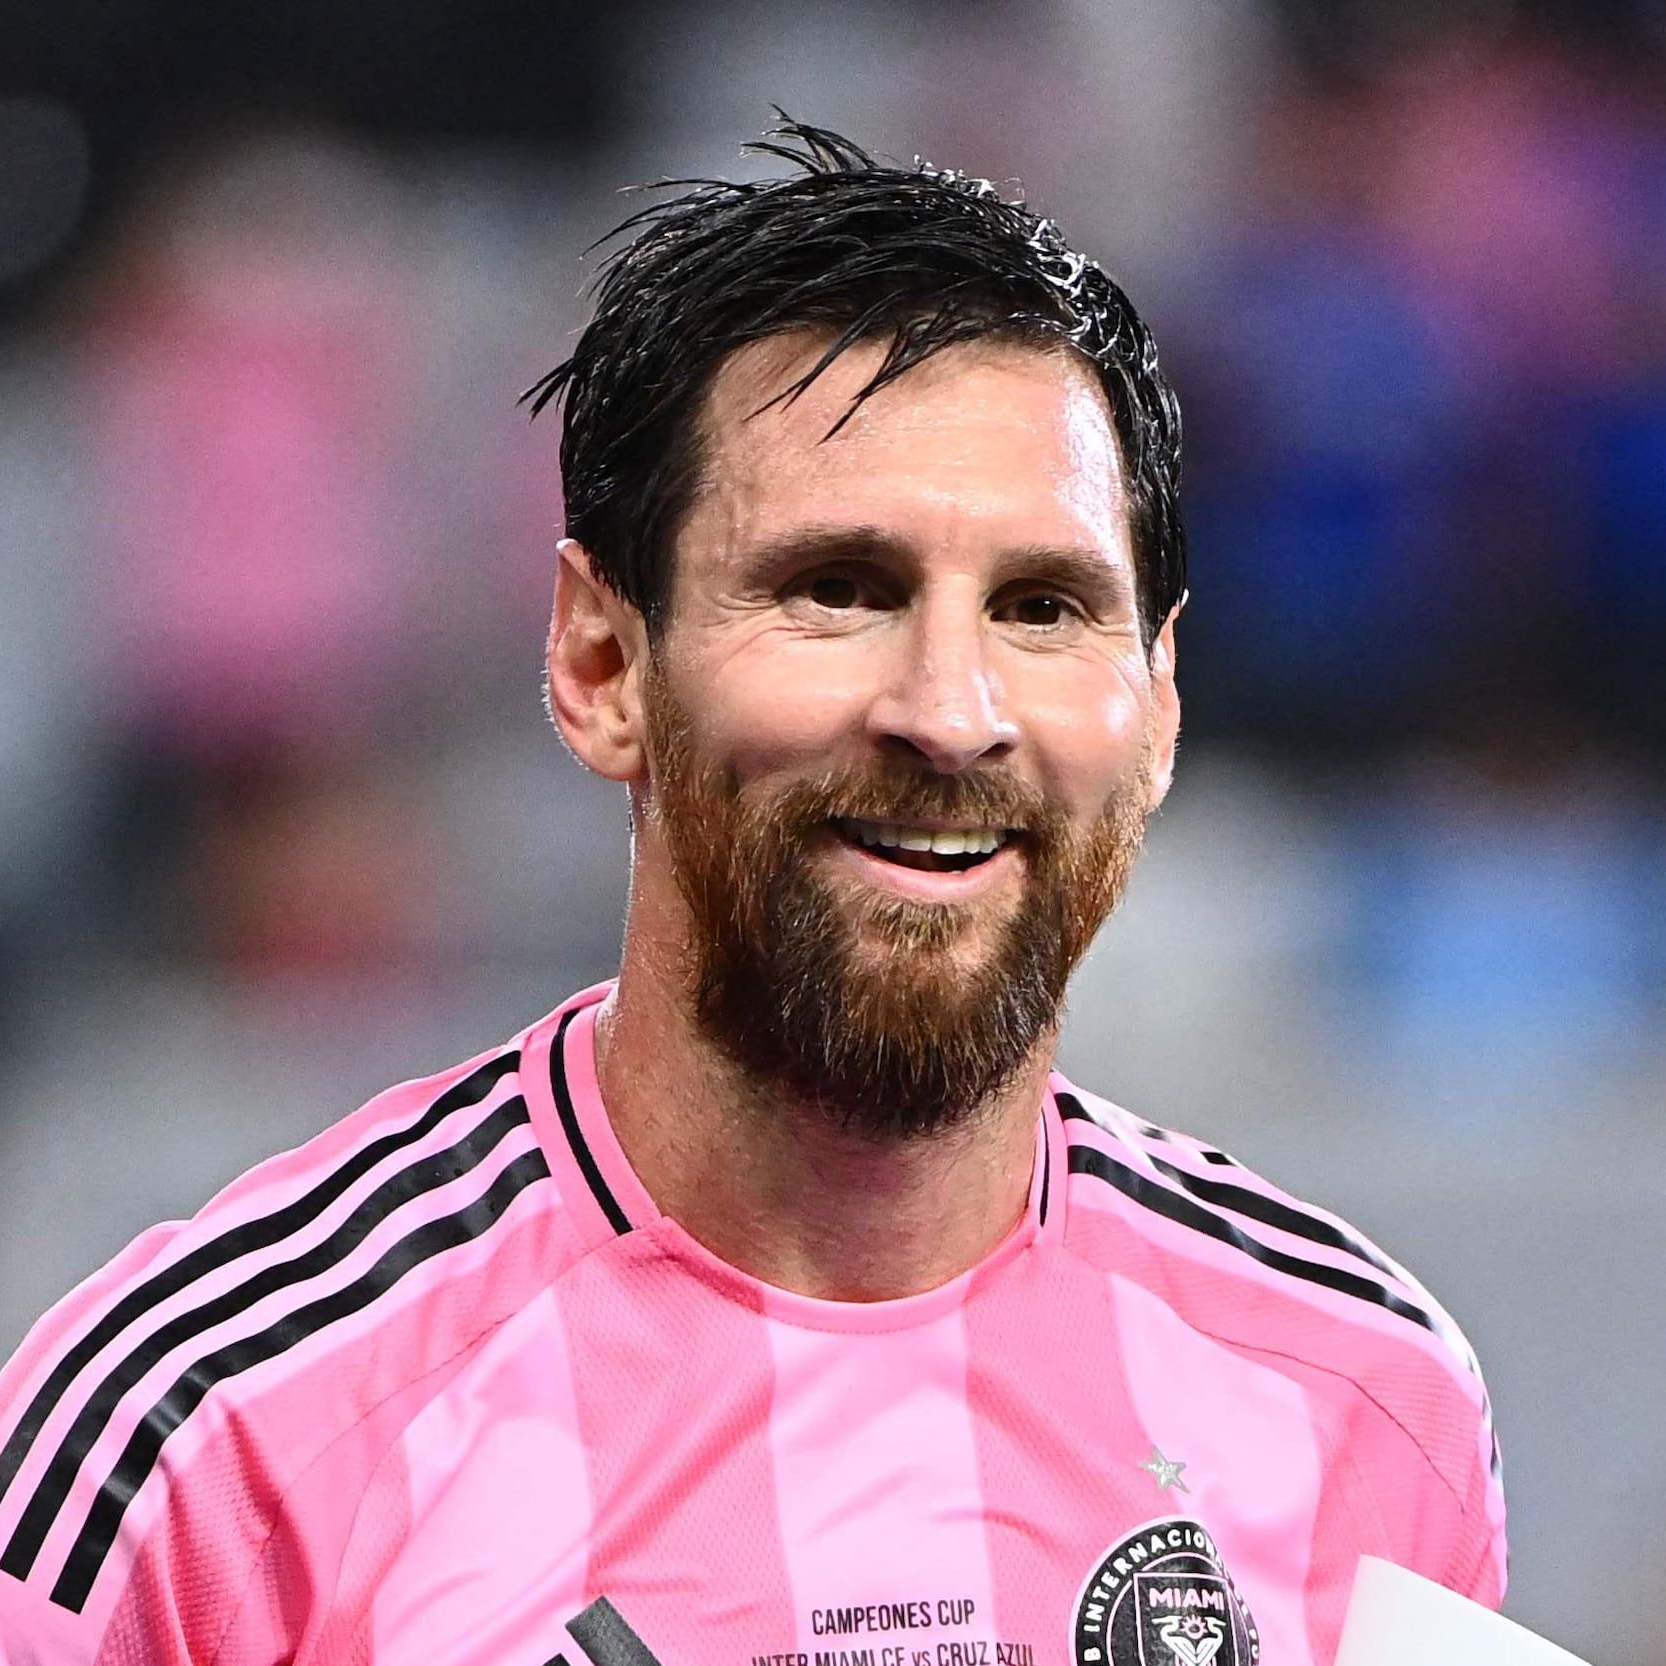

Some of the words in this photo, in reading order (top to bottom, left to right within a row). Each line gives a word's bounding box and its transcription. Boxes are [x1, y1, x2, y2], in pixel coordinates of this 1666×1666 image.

[1149, 1587, 1225, 1611] MIAMI
[812, 1601, 932, 1635] CAMPEONES
[938, 1599, 975, 1626] CUP
